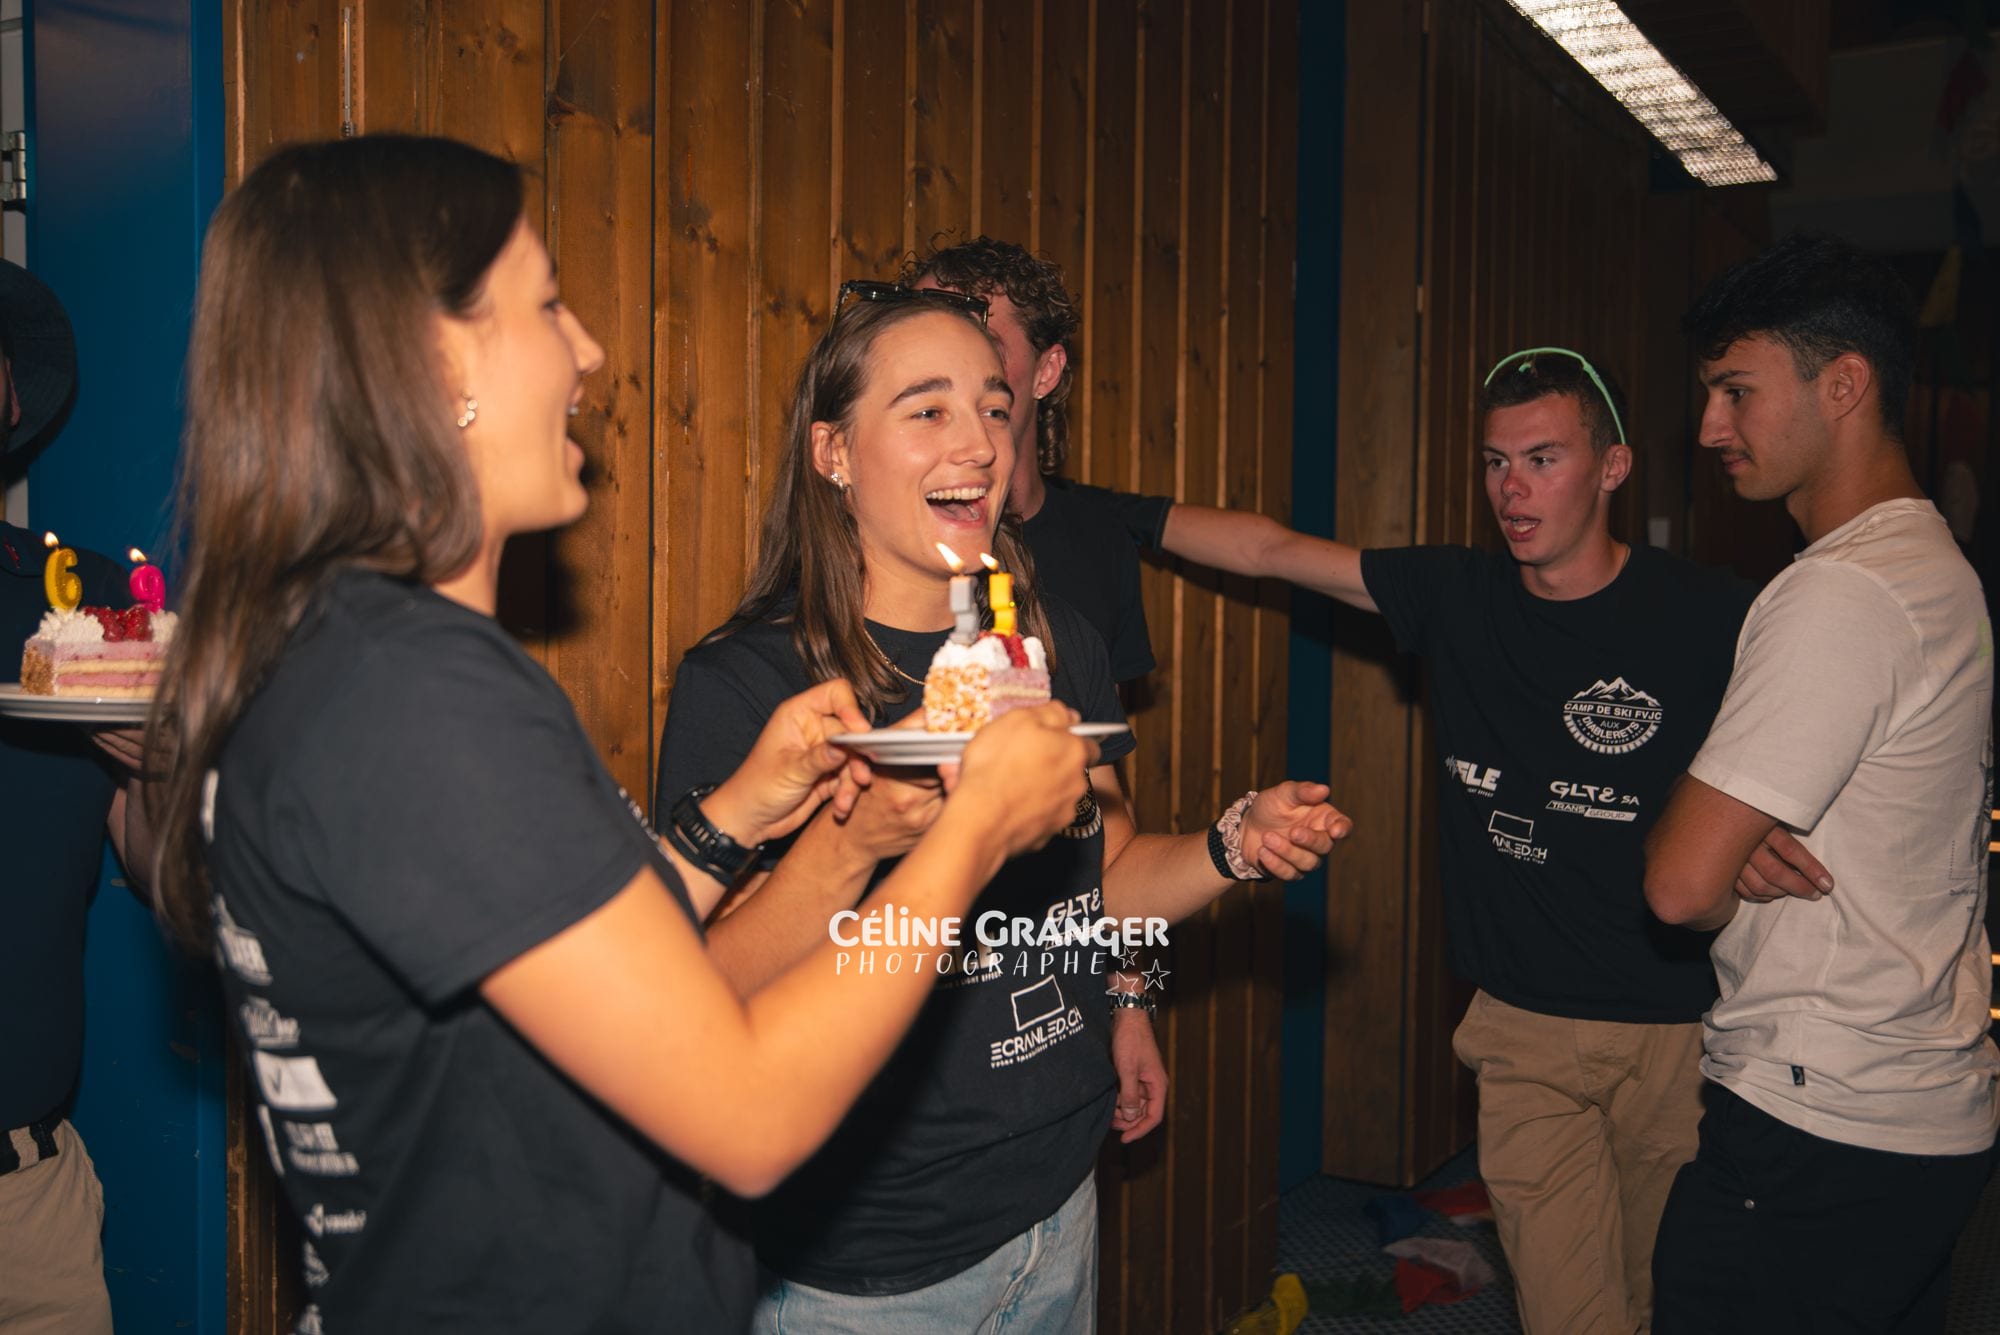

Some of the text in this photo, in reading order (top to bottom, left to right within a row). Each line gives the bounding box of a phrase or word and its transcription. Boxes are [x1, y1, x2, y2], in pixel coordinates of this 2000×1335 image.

[1564, 703, 1662, 720] CAMP DE SKI FVJC
[1582, 716, 1640, 739] DIABLERETS
[1600, 720, 1620, 729] AUX
[1620, 795, 1640, 806] SA
[1552, 801, 1626, 819] TRANS GROUP
